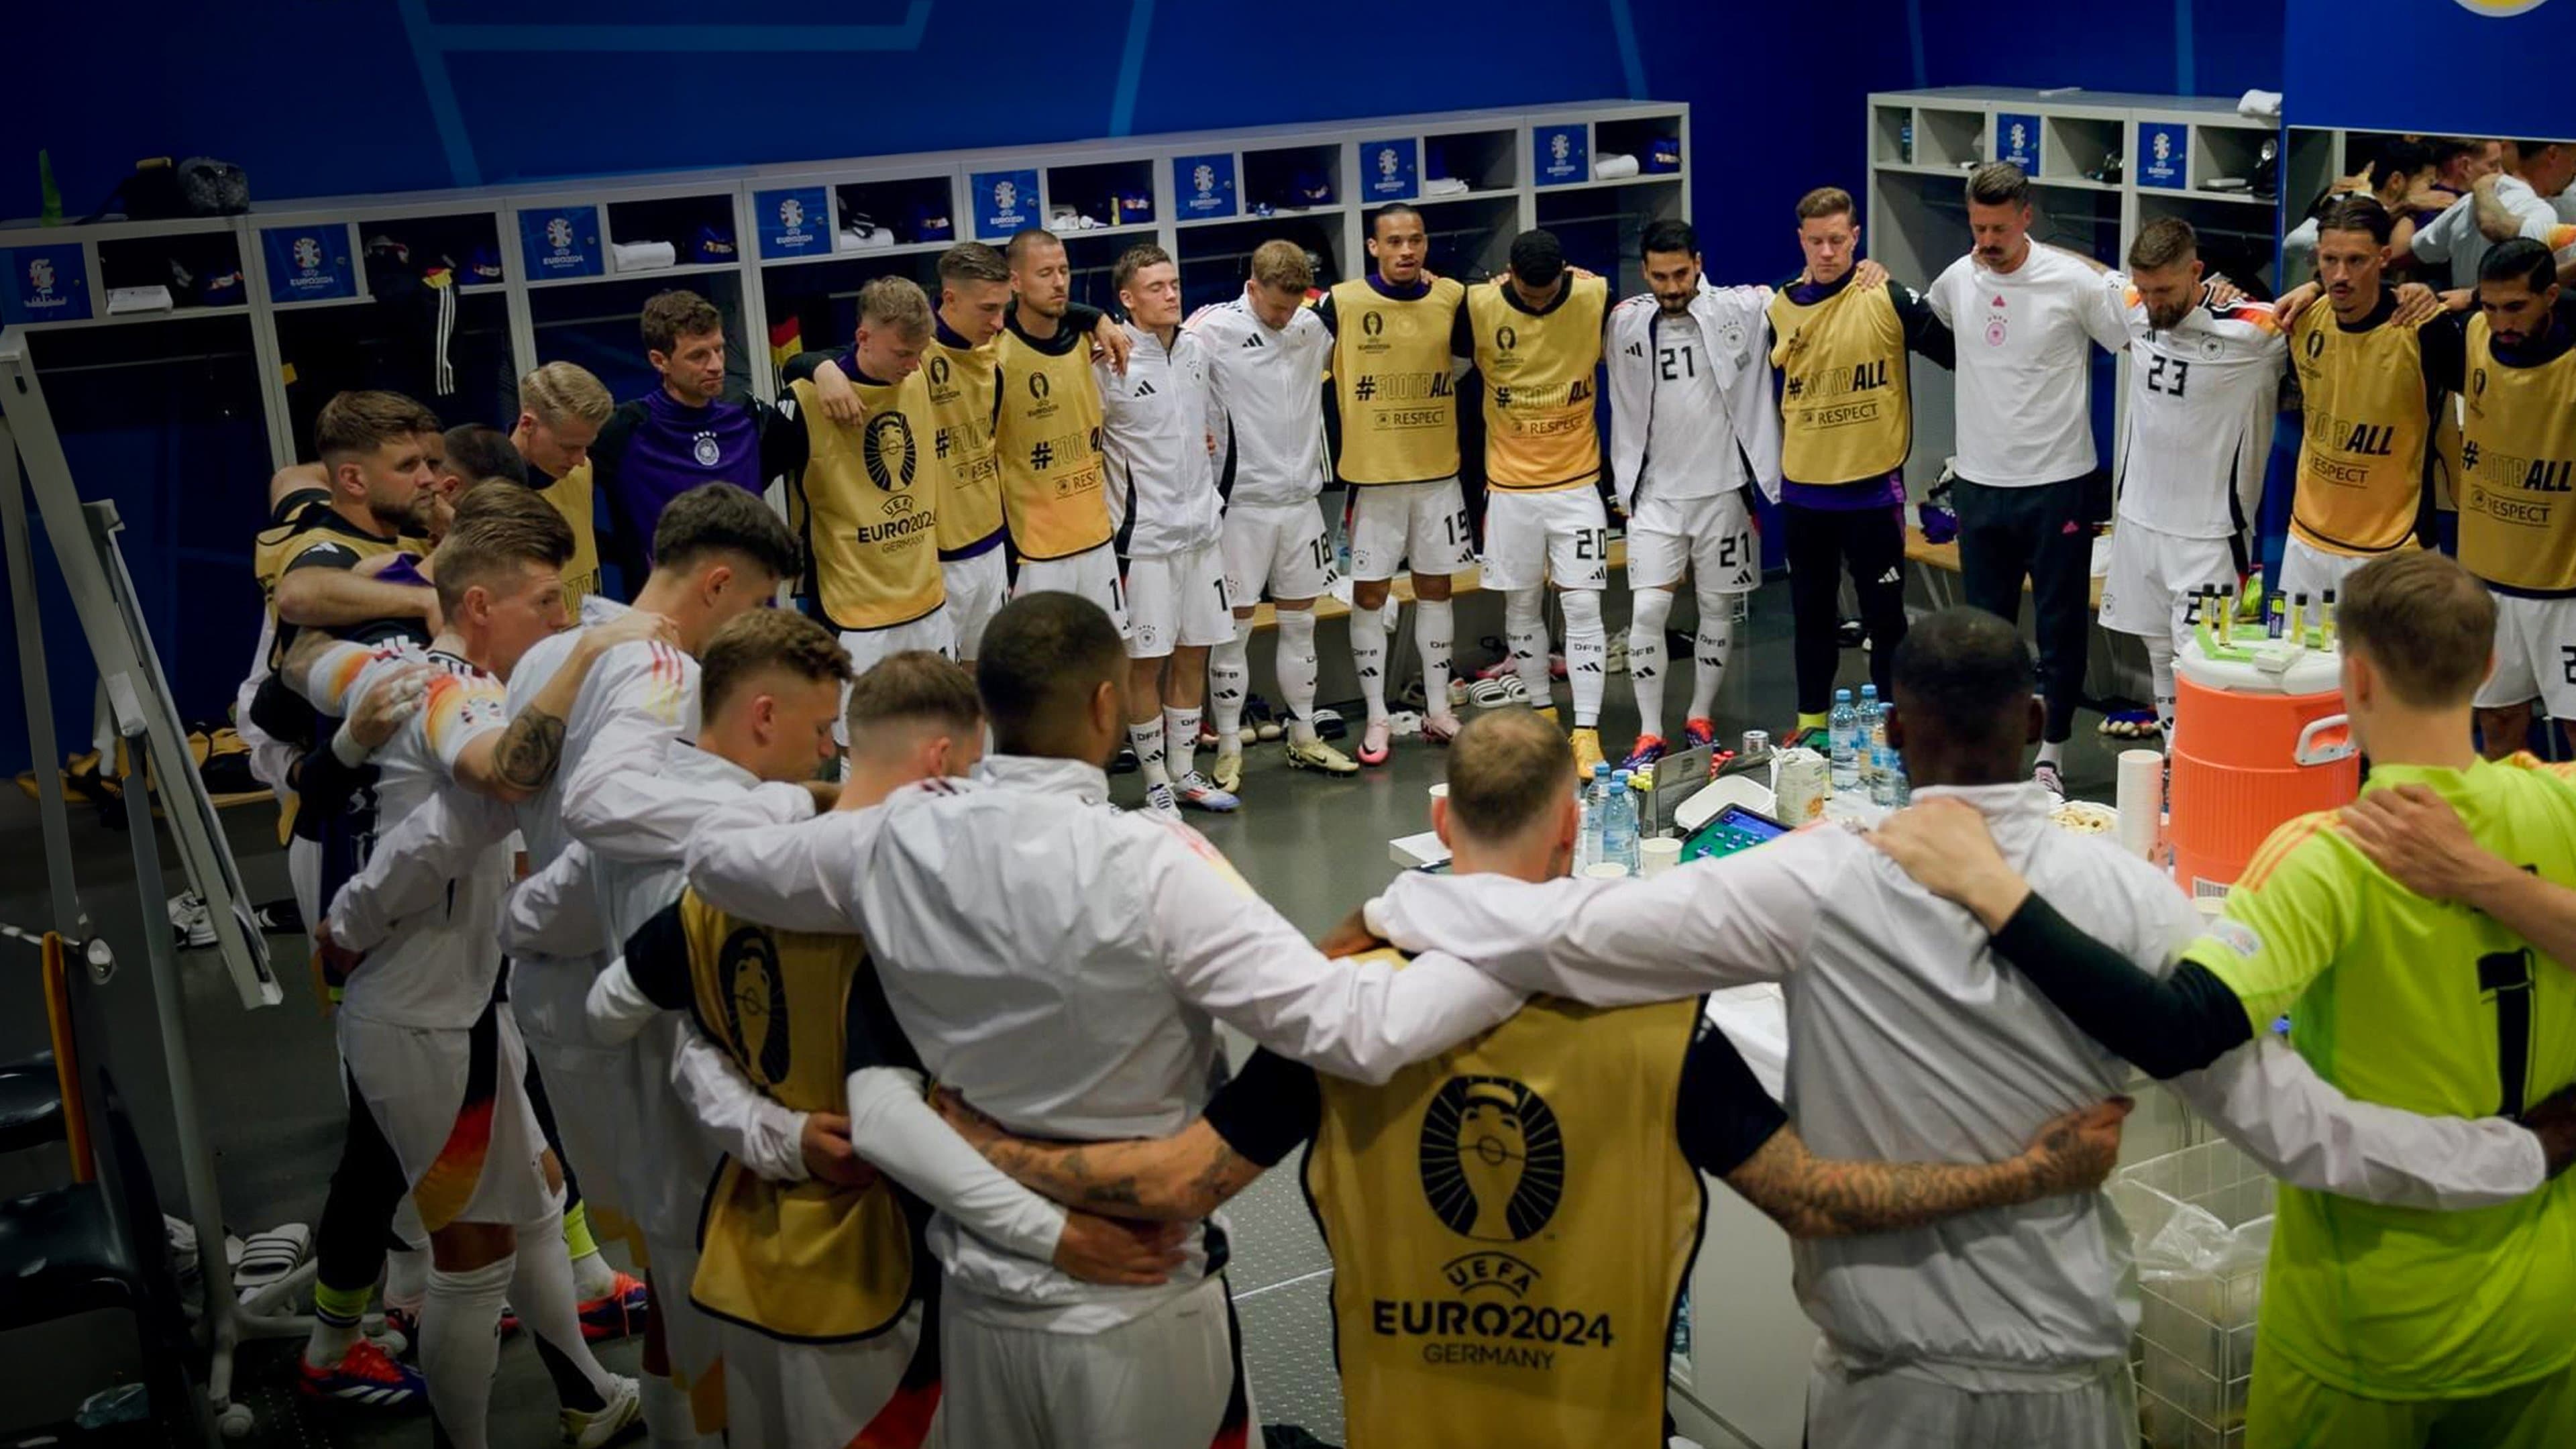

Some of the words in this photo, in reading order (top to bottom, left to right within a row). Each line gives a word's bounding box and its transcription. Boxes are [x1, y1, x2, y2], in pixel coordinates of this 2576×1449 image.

[1660, 345, 1695, 380] 21
[2148, 354, 2189, 397] 23
[1393, 410, 1444, 425] RESPECT
[1819, 403, 1878, 425] RESPECT
[1444, 510, 1470, 545] 19
[1576, 528, 1607, 559] 20
[1309, 532, 1333, 569] 18
[1720, 531, 1750, 568] 21
[1574, 643, 1602, 652] DFB
[1447, 1259, 1532, 1293] UEFA
[1373, 1299, 1613, 1348] EURO2024
[1423, 1342, 1557, 1370] GERMANY
